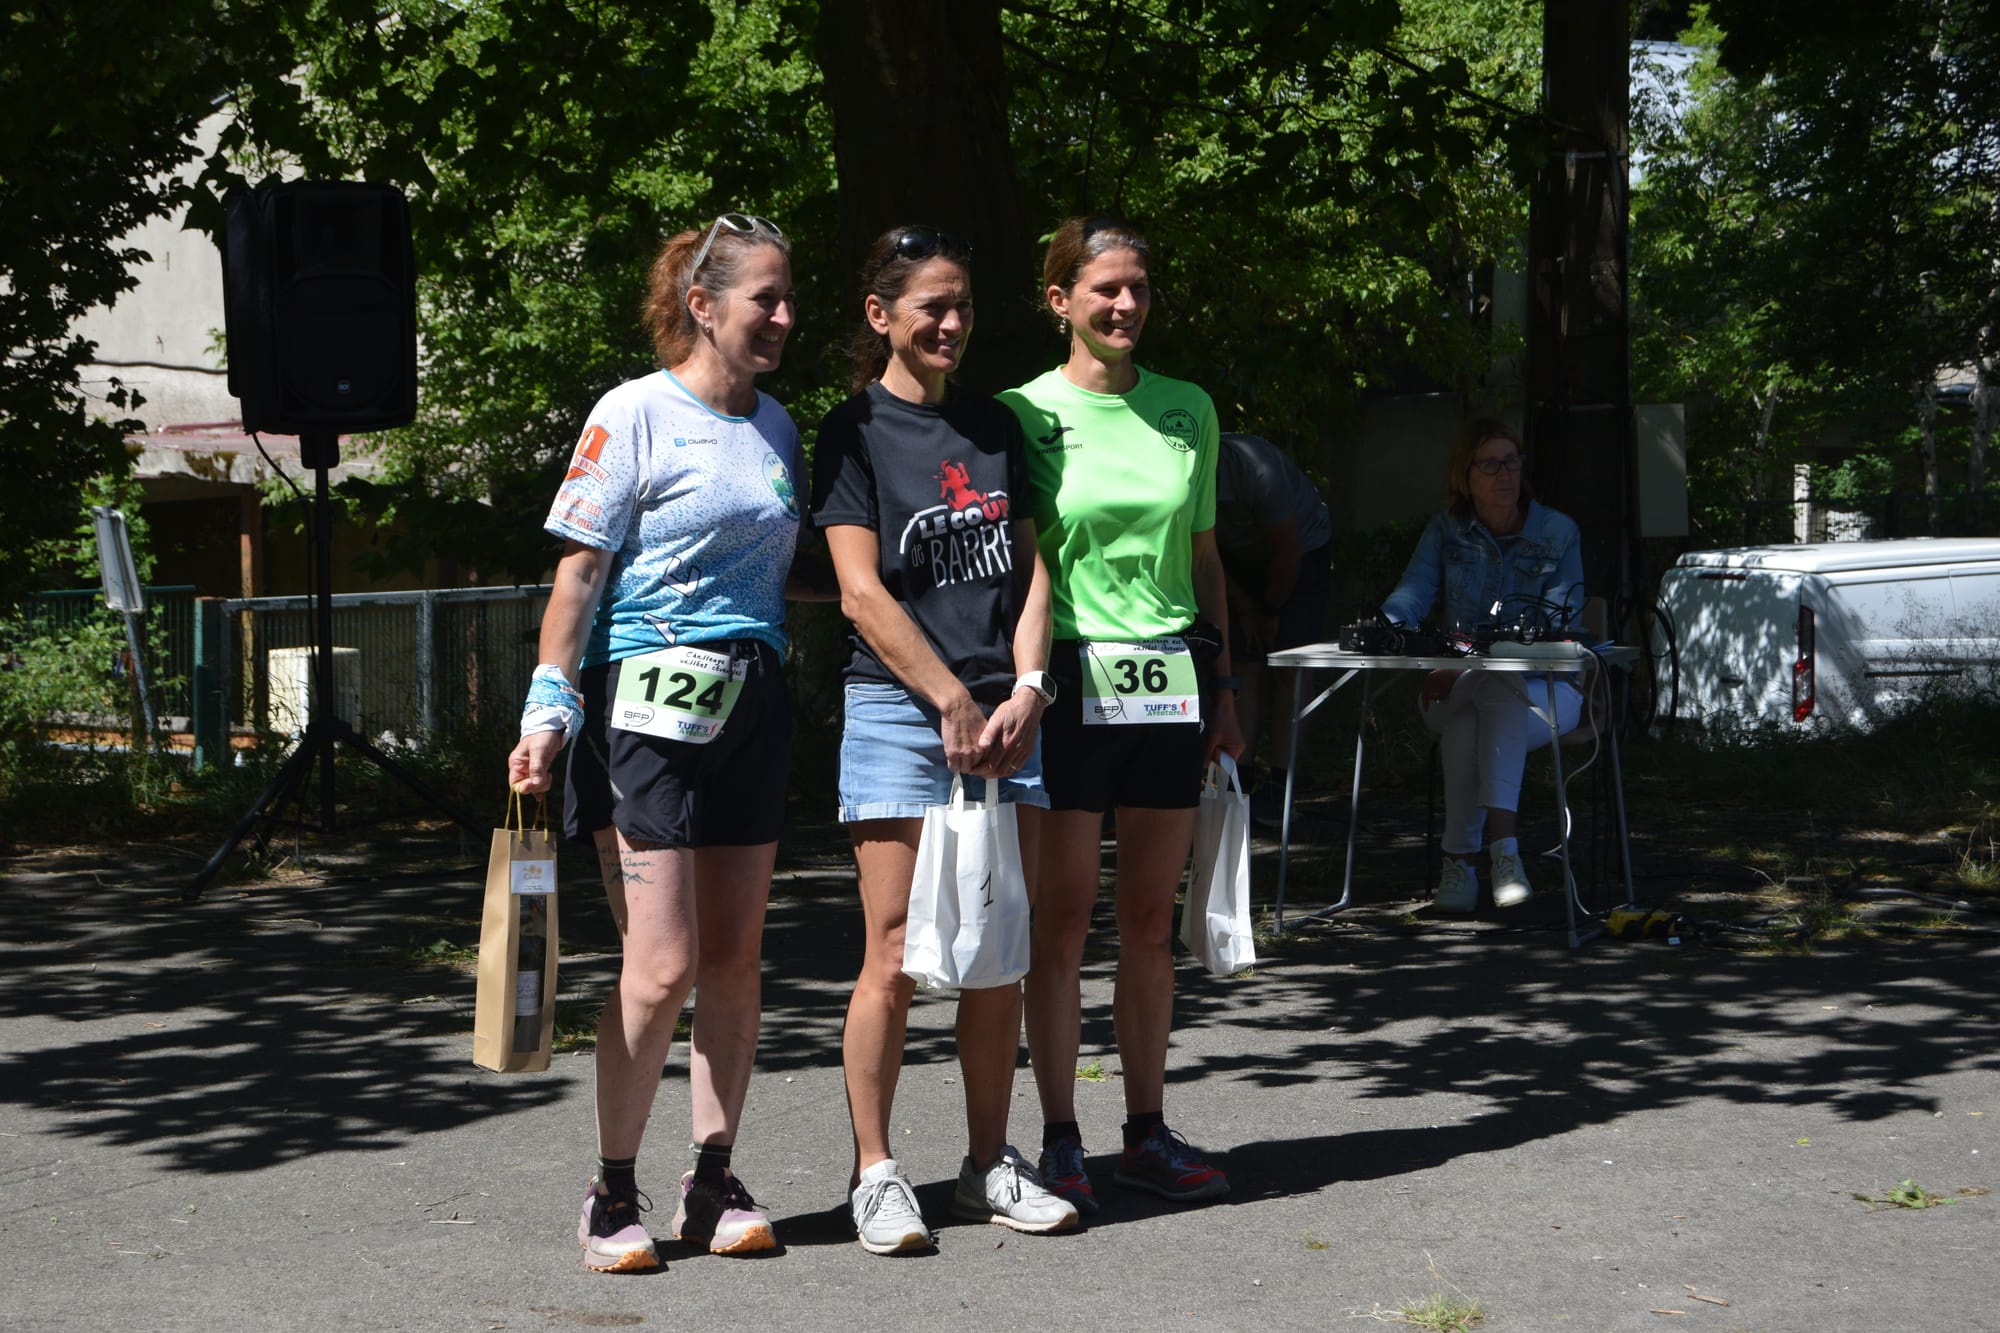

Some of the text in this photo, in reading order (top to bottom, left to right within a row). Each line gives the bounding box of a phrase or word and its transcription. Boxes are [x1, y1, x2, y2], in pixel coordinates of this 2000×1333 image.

[918, 514, 948, 539] LE
[911, 543, 925, 567] de
[686, 651, 725, 665] Challenge
[1114, 658, 1168, 694] 36
[638, 666, 726, 716] 124
[623, 711, 650, 721] BFP
[1095, 705, 1119, 713] BFP
[1144, 703, 1177, 712] TUFF'S
[677, 720, 709, 733] TUFF'S
[980, 870, 993, 907] 1
